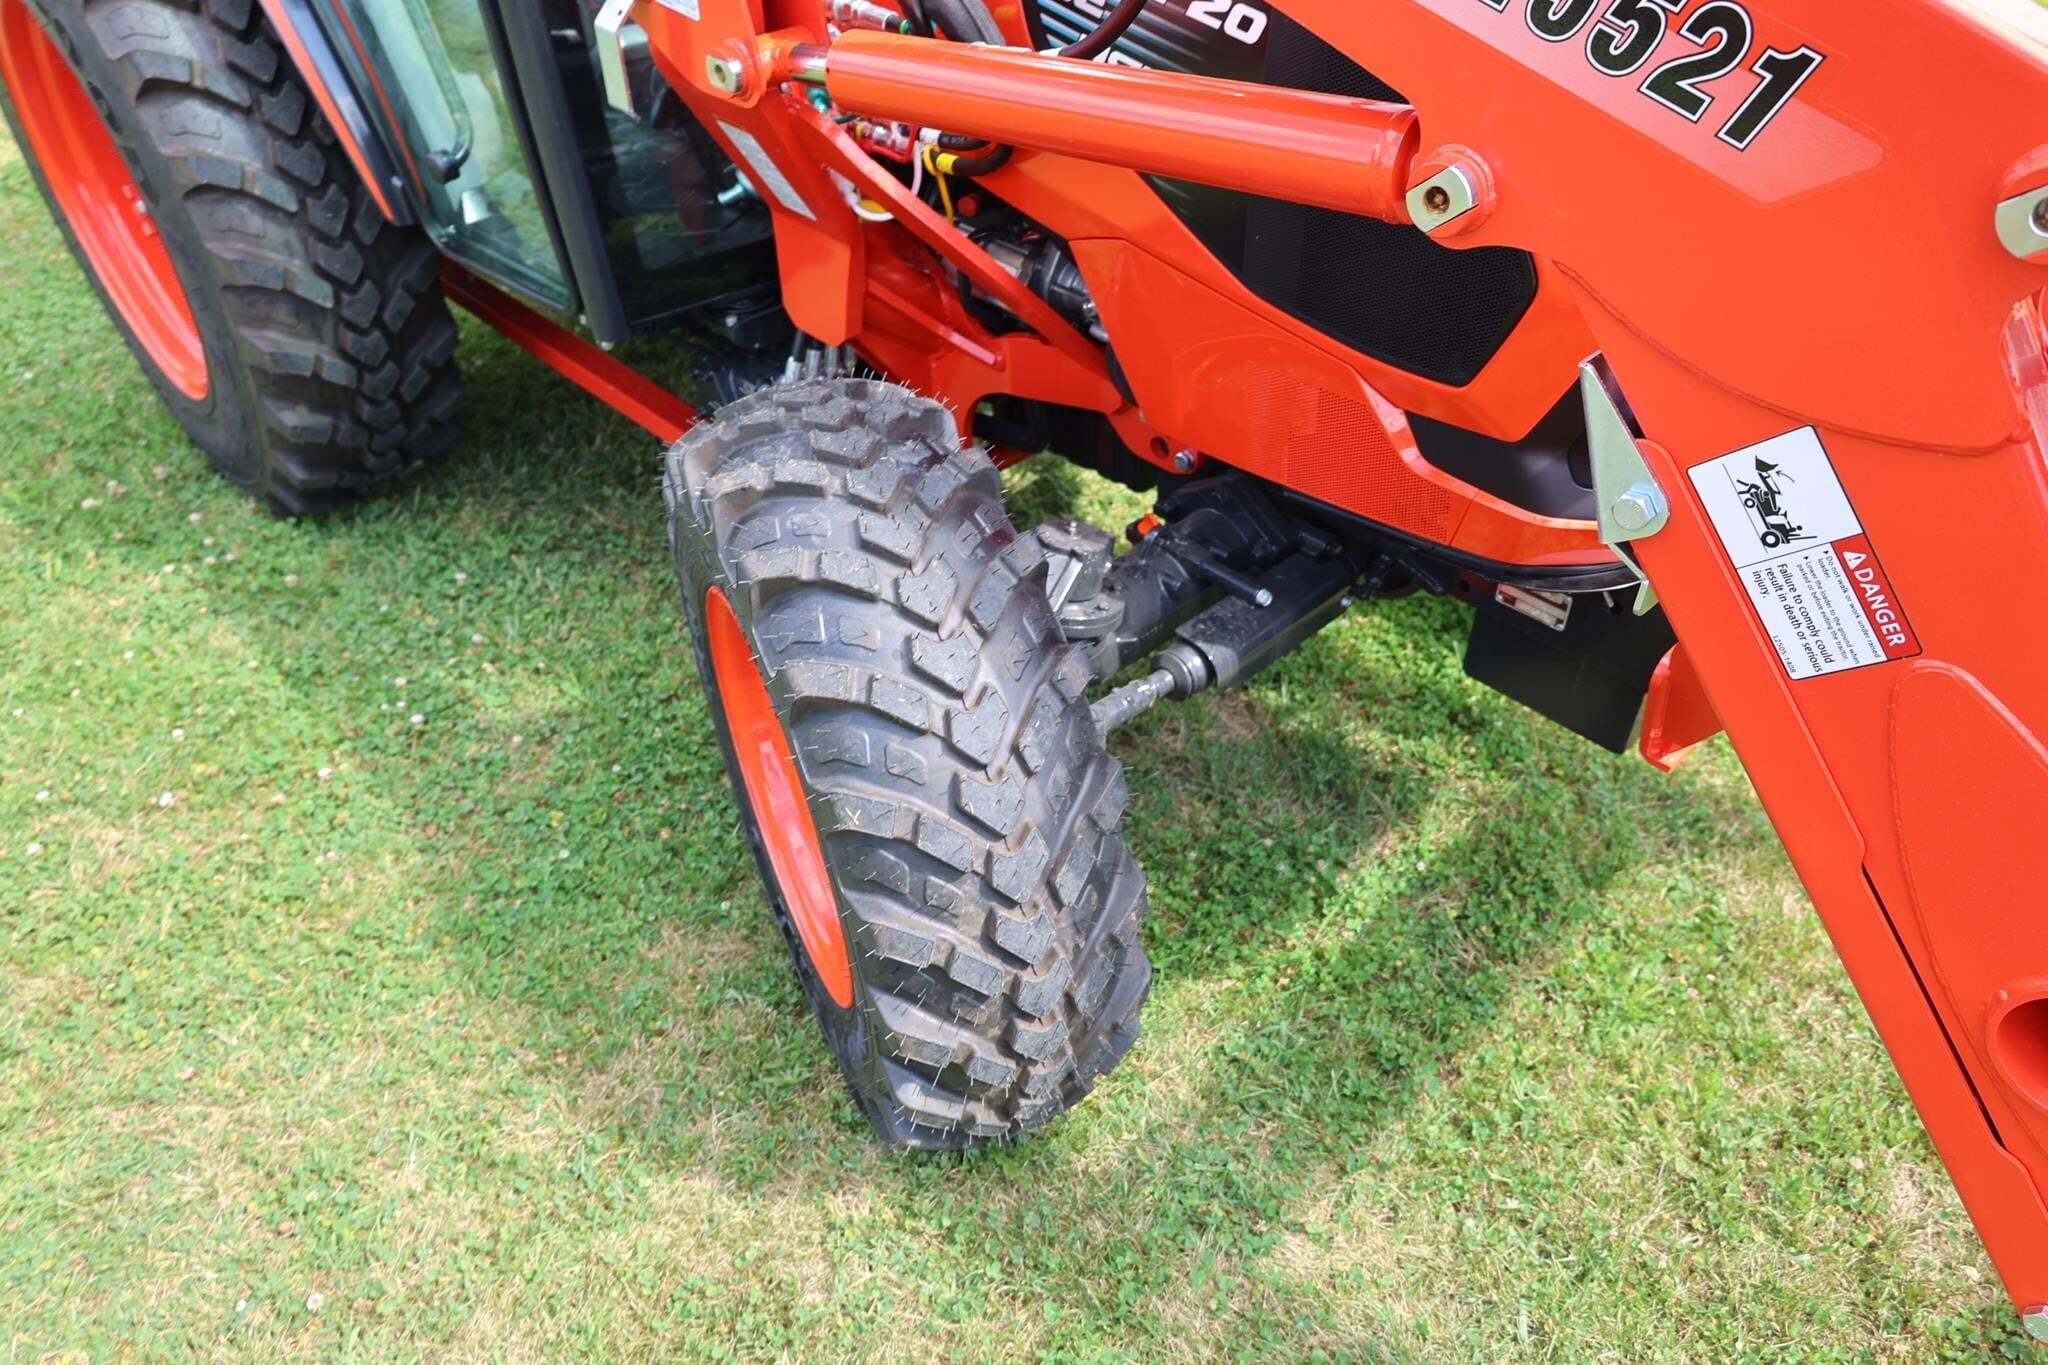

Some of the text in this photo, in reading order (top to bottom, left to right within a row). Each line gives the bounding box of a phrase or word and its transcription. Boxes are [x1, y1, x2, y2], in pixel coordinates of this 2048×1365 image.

[1154, 0, 1268, 45] 20
[1474, 0, 1826, 152] 521
[1751, 570, 1769, 598] injury.
[1764, 567, 1823, 672] result in death or serious
[1776, 562, 1835, 663] Failure to comply could
[1795, 563, 1811, 584] parked
[1806, 583, 1814, 591] or
[1810, 590, 1823, 610] before
[1829, 629, 1838, 640] the
[1805, 560, 1860, 664] Lower the loader to the ground when
[1825, 555, 1881, 658] Do not walk or work under raised
[1854, 567, 1905, 646] DANGER
